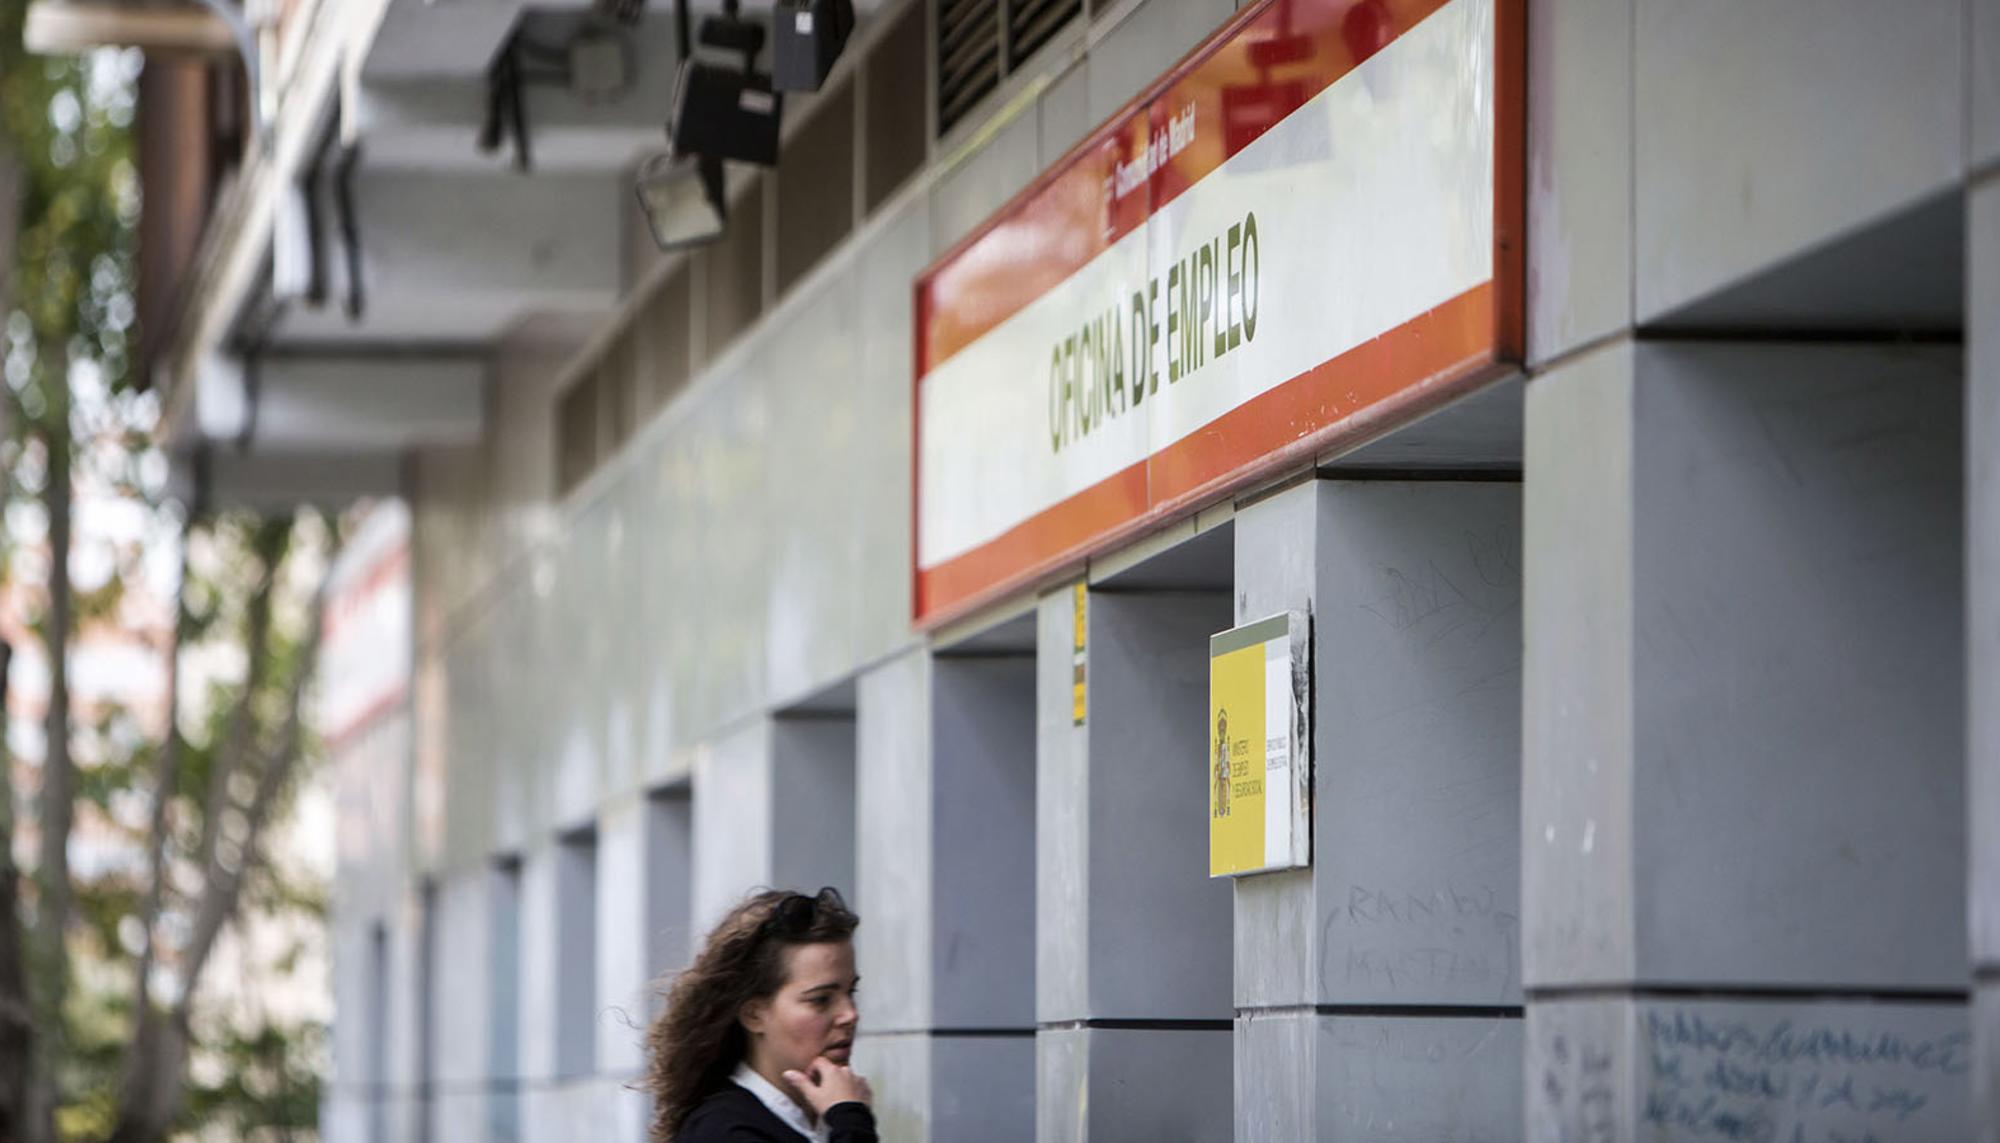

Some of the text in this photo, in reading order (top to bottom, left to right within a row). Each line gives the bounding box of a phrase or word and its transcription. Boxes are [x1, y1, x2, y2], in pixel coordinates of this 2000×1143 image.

[1168, 100, 1195, 158] Madrid
[1050, 211, 1258, 454] OFICINA DE EMPLEO
